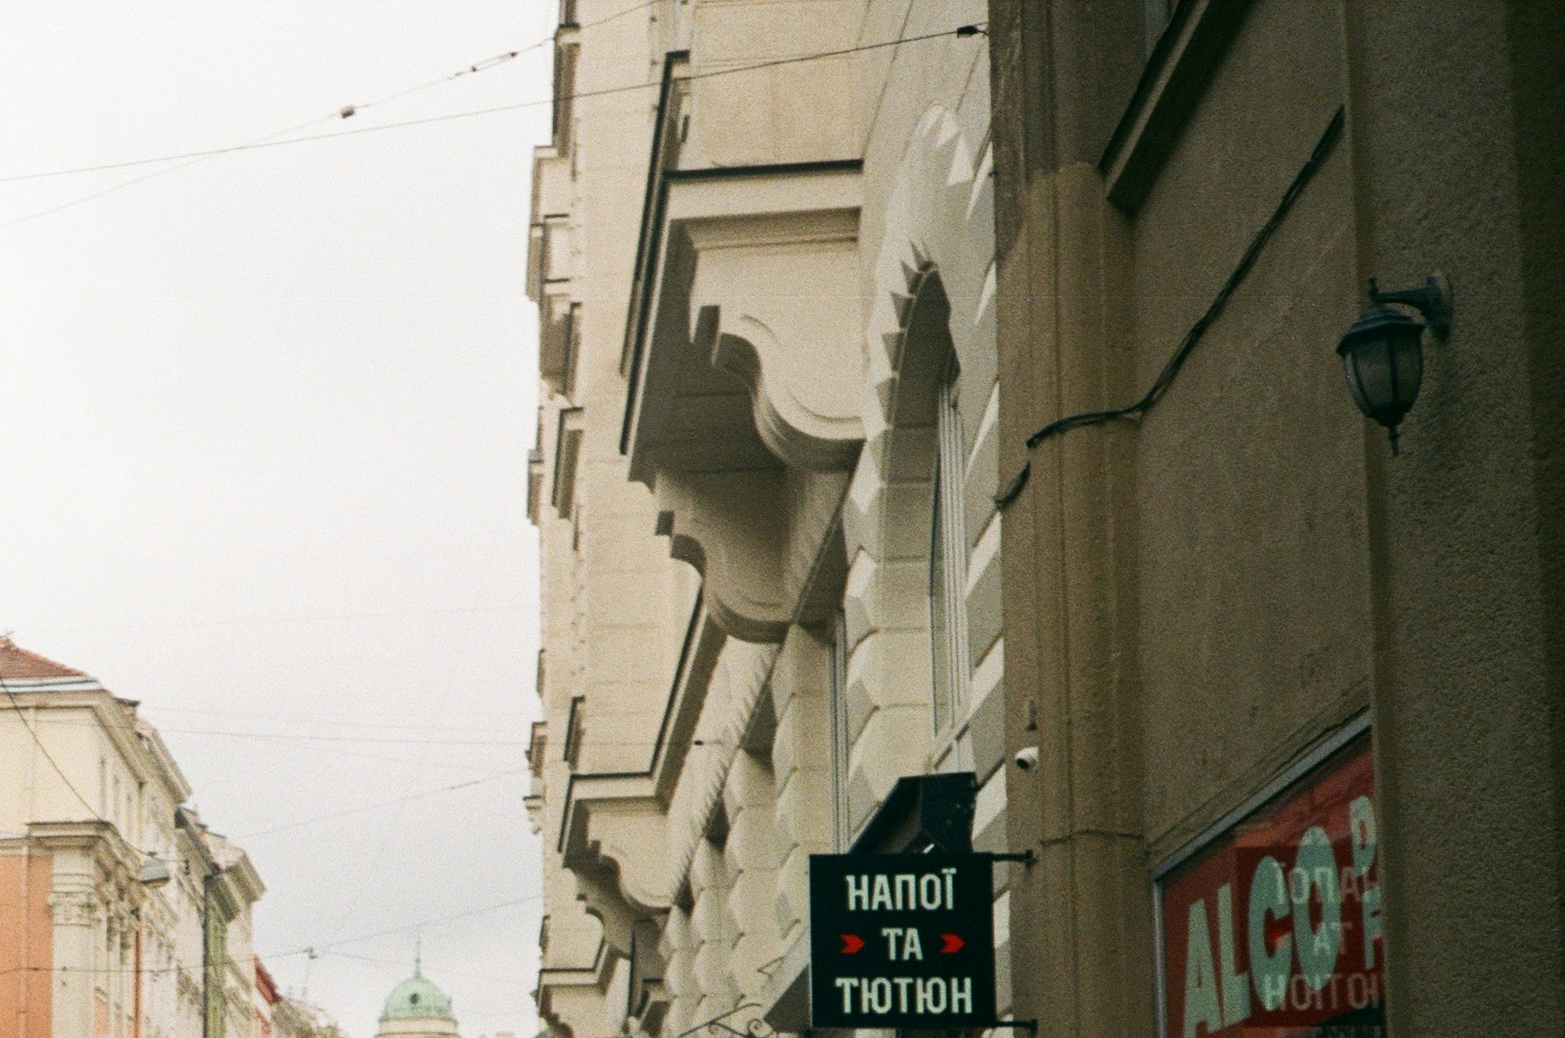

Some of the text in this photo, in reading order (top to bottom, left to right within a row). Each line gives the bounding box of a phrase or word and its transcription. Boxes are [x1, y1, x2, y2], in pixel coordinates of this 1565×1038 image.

[846, 867, 956, 911] НАПОЇ
[882, 928, 923, 961] ТА
[836, 976, 972, 1015] ТЮТЮН
